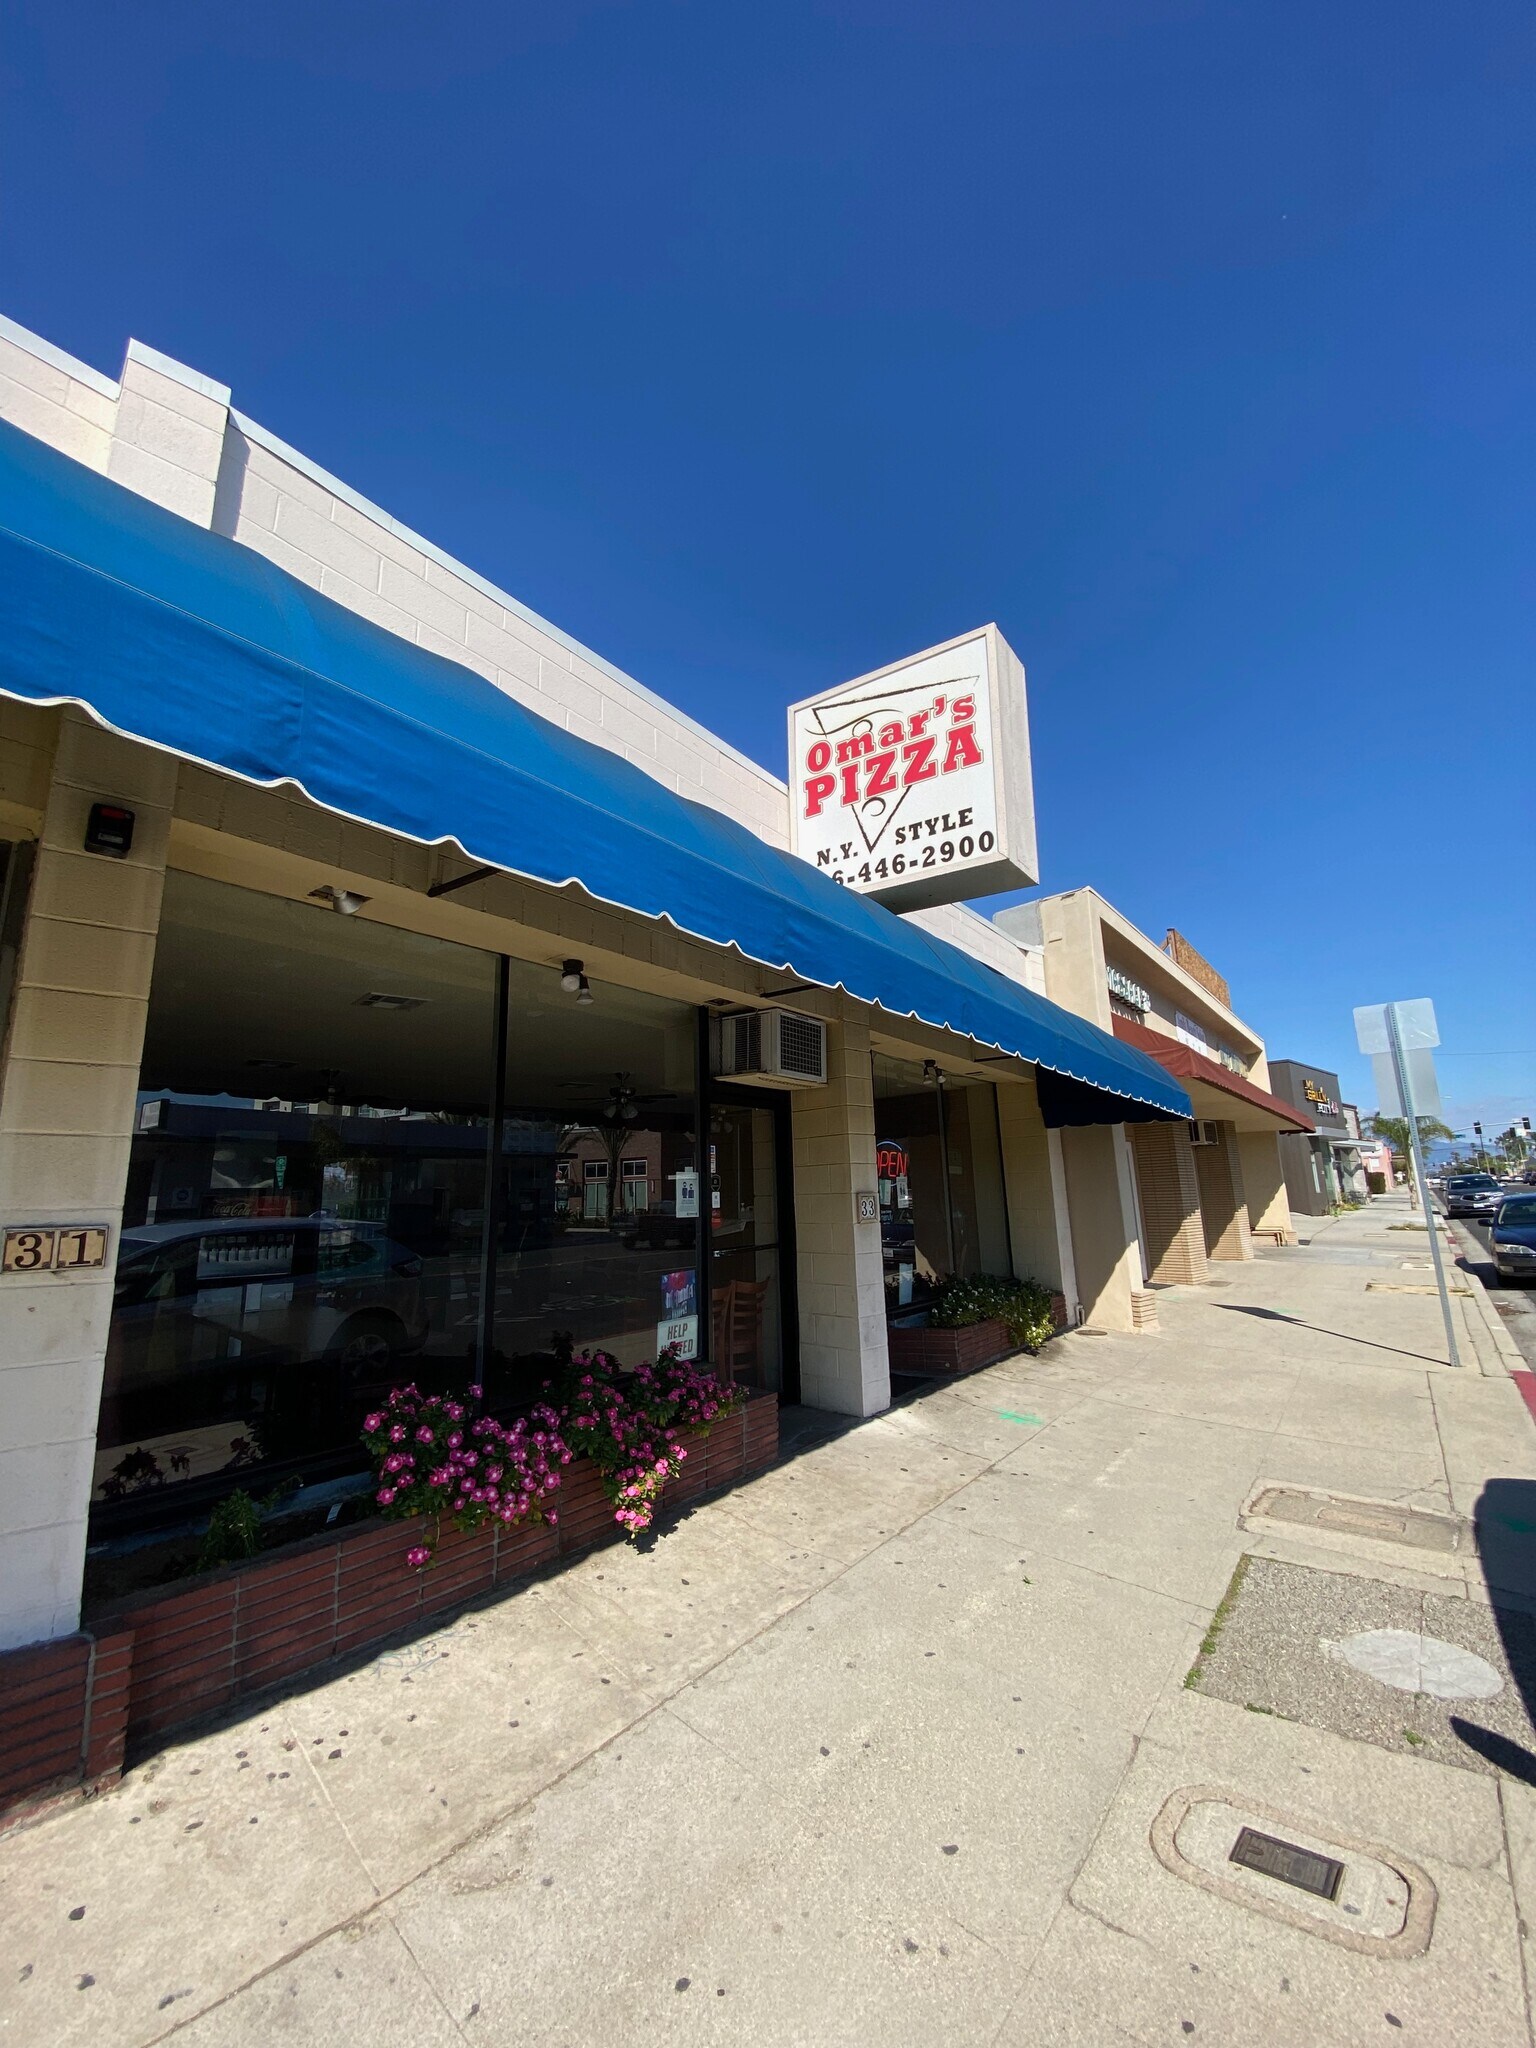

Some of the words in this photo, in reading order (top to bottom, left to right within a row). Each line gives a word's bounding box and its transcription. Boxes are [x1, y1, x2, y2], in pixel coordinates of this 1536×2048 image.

[806, 693, 975, 773] Omar's
[804, 722, 983, 819] PIZZA
[817, 841, 858, 867] N.Y.
[895, 807, 974, 845] STYLE
[861, 1200, 874, 1217] 33
[667, 1322, 688, 1340] HELP
